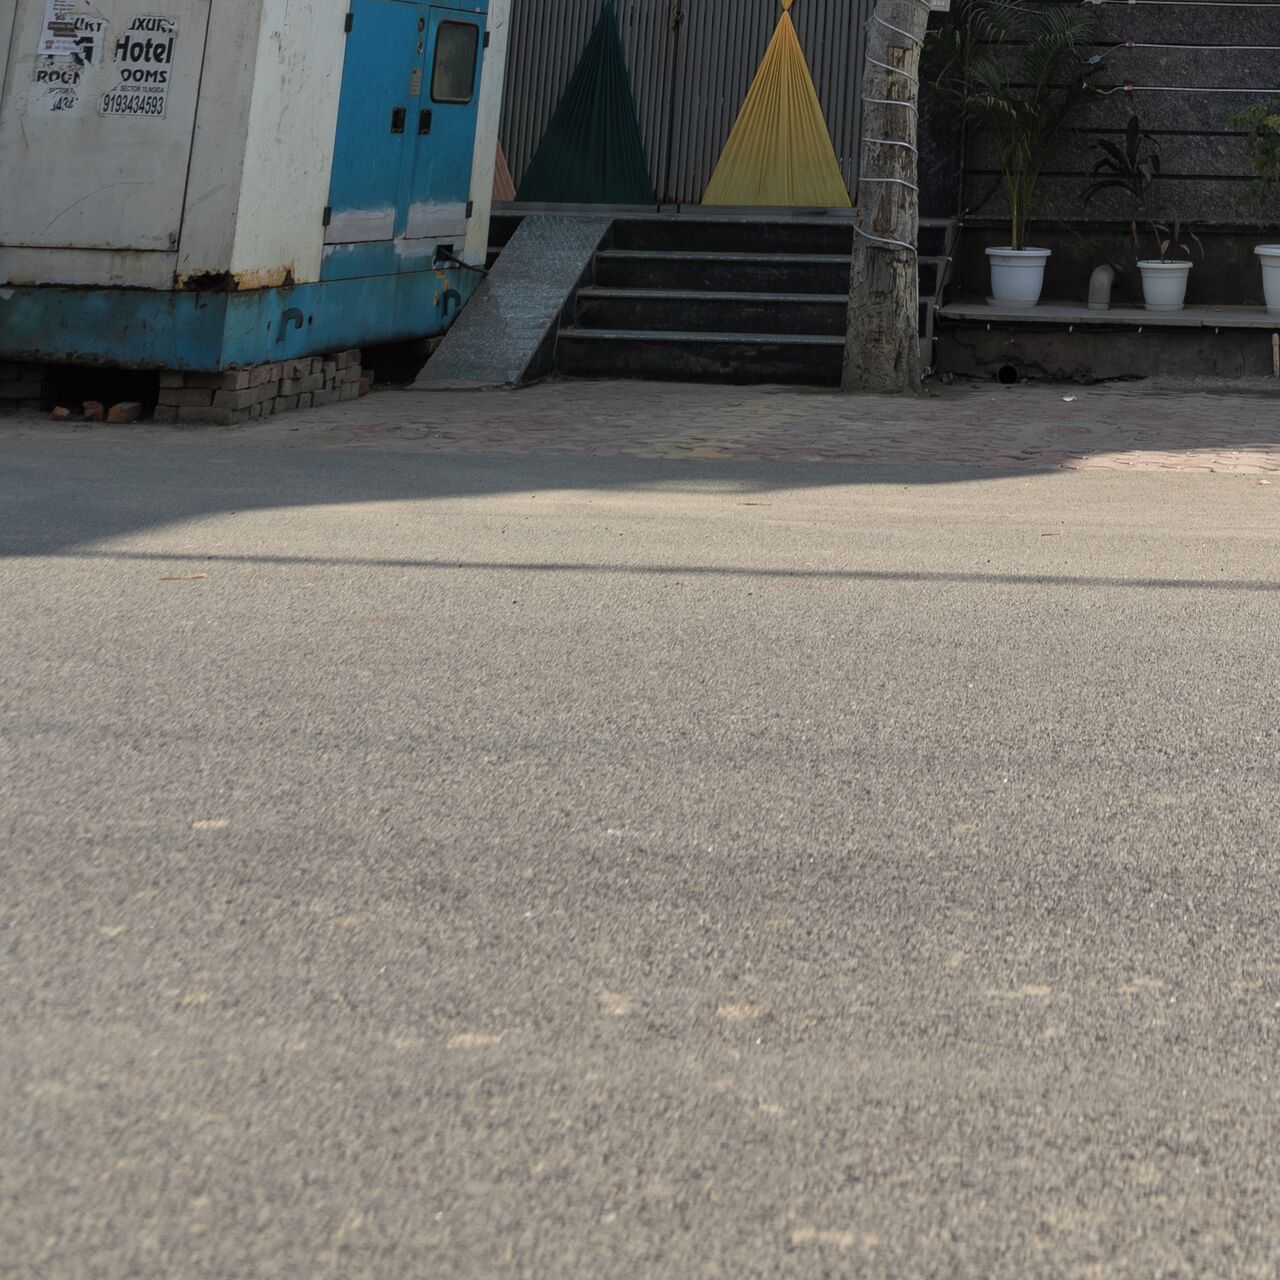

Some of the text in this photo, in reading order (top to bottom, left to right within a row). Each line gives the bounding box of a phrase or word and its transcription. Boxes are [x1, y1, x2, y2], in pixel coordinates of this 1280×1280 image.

[113, 35, 174, 64] Hotel
[120, 69, 167, 83] OOMS
[120, 85, 142, 93] SECTOR
[102, 94, 164, 115] 9193434593
